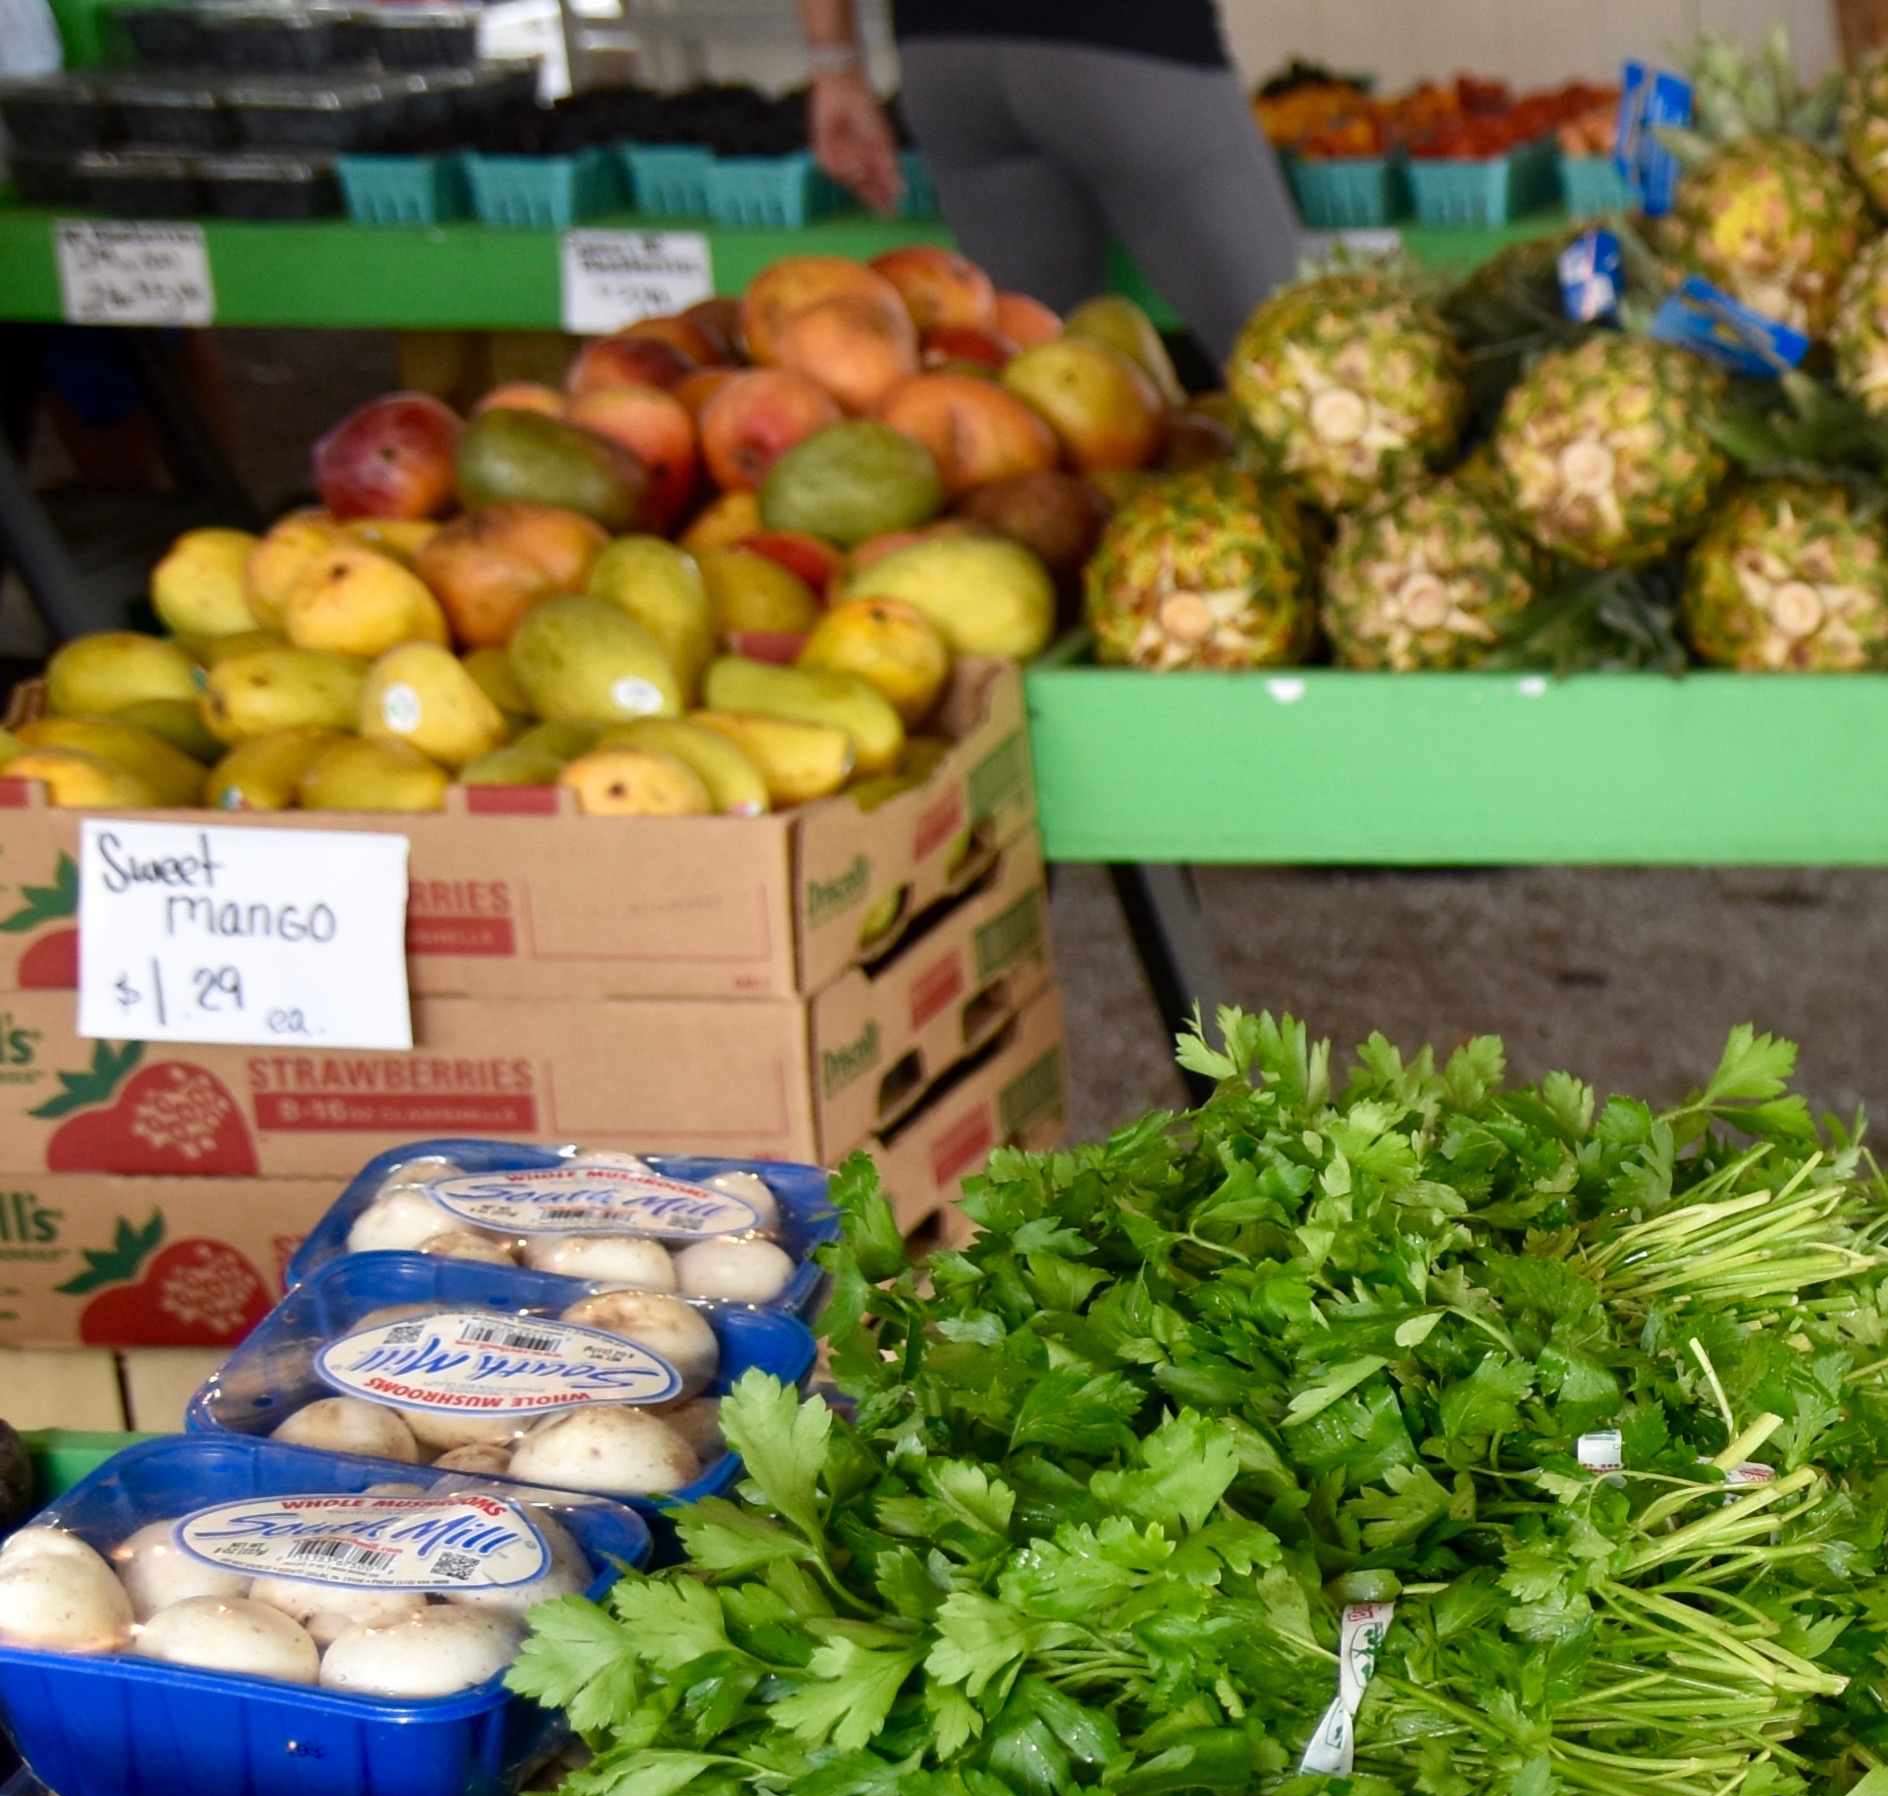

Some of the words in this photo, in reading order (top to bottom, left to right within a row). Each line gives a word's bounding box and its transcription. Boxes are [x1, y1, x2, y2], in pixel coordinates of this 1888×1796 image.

[98, 832, 224, 893] Sweet
[408, 880, 512, 914] RRIES
[114, 956, 246, 1028] $1.29
[247, 1055, 537, 1091] STRAWBERRIES
[445, 1183, 614, 1206] South
[620, 1195, 730, 1218] Mill
[350, 1336, 472, 1379] Mill
[470, 1354, 660, 1390] South
[362, 1376, 505, 1408] MUSHROOMS
[510, 1391, 592, 1408] WHOLE
[281, 1499, 366, 1511] WHOLE
[193, 1512, 403, 1540] South
[391, 1513, 520, 1558] Mill
